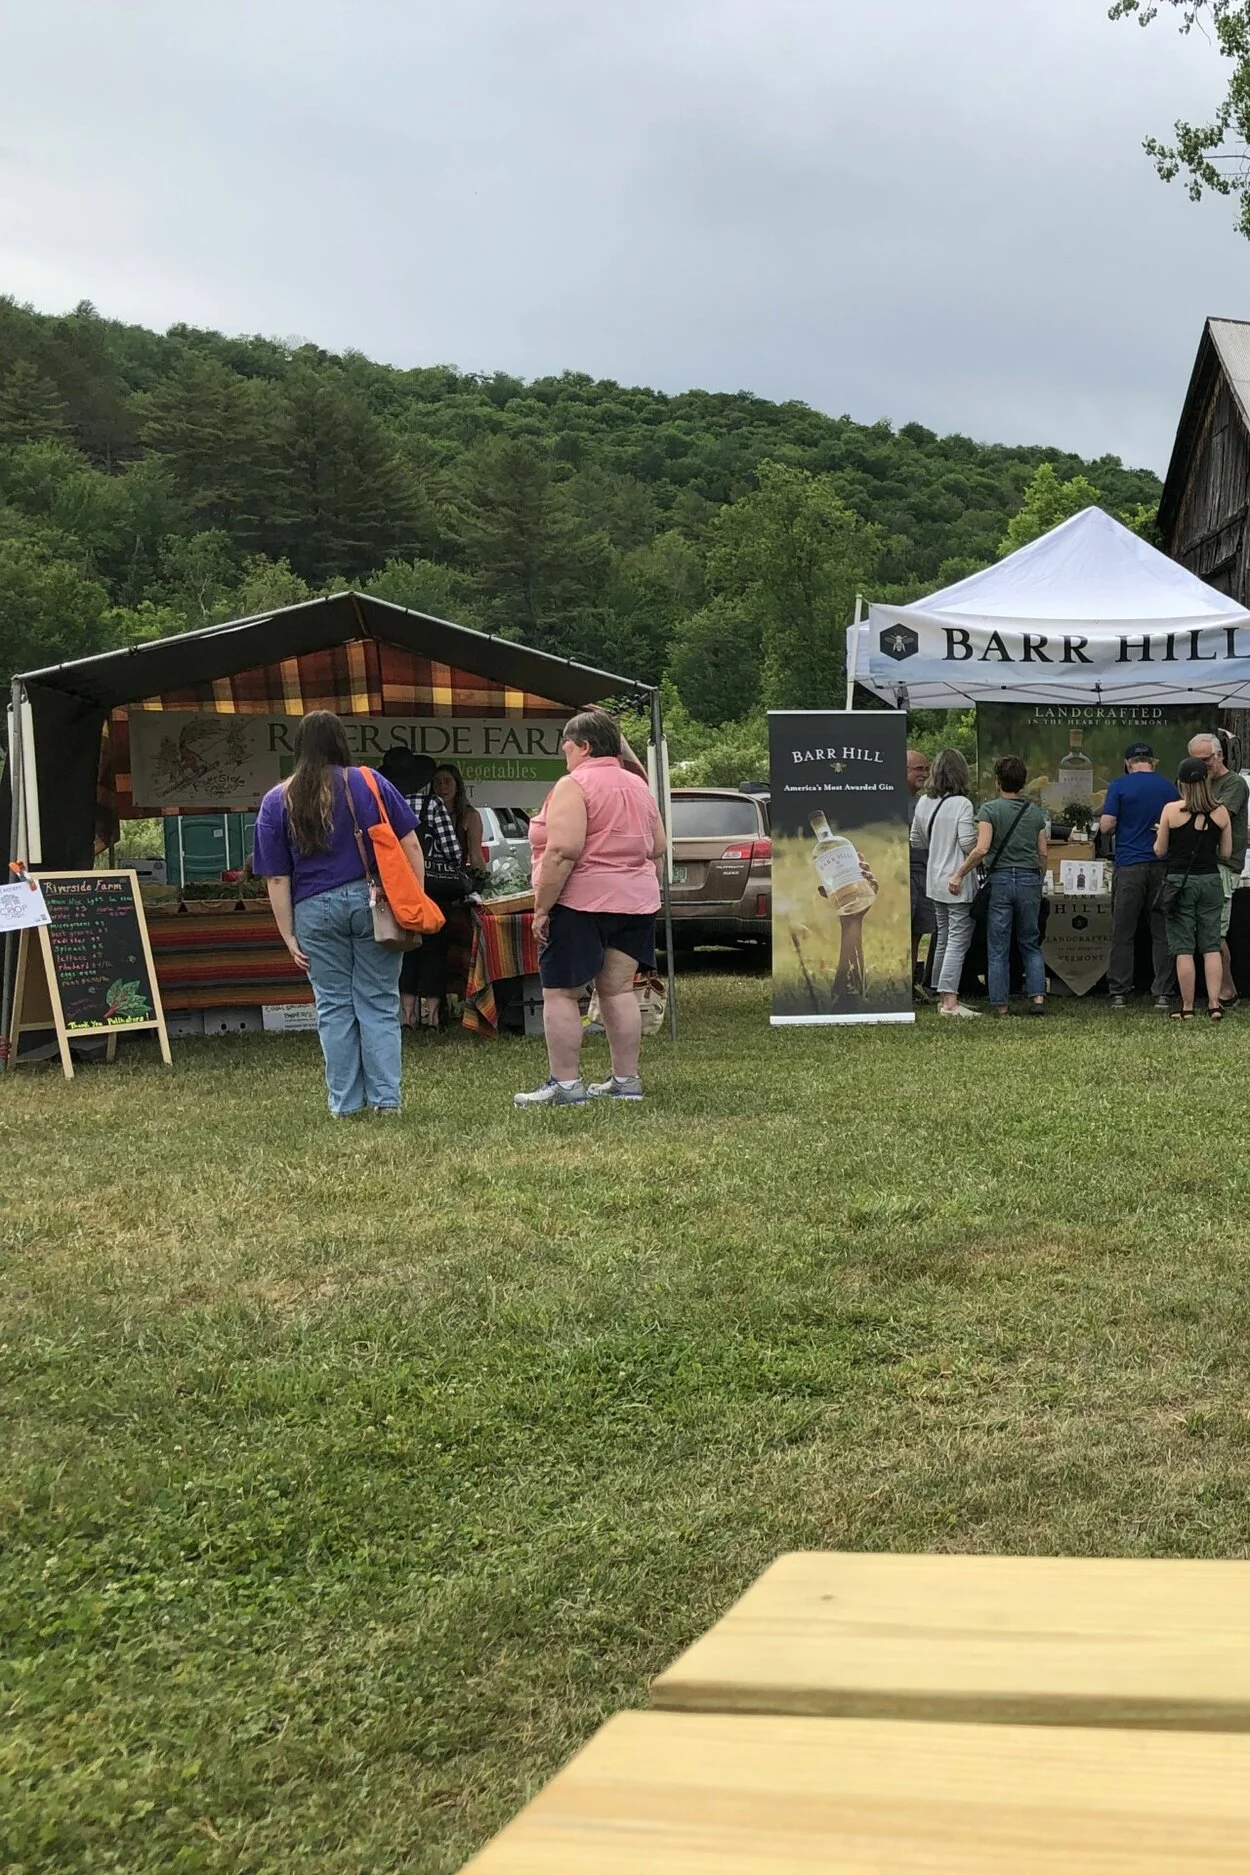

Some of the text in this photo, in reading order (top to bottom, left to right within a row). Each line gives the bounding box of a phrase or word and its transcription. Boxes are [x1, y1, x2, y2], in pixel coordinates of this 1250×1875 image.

[942, 627, 1094, 664] BARR
[1035, 706, 1163, 719] LANDCRAFTED
[267, 723, 471, 755] RERSIDE
[792, 747, 883, 763] BARR HILL
[457, 758, 537, 784] Vegetables
[784, 783, 822, 792] America's
[844, 783, 877, 791] Awarded
[878, 783, 894, 791] Gin
[44, 879, 122, 894] Riverside Farm
[1055, 904, 1106, 914] HILL
[68, 1021, 89, 1029] Thank
[90, 1020, 103, 1028] You
